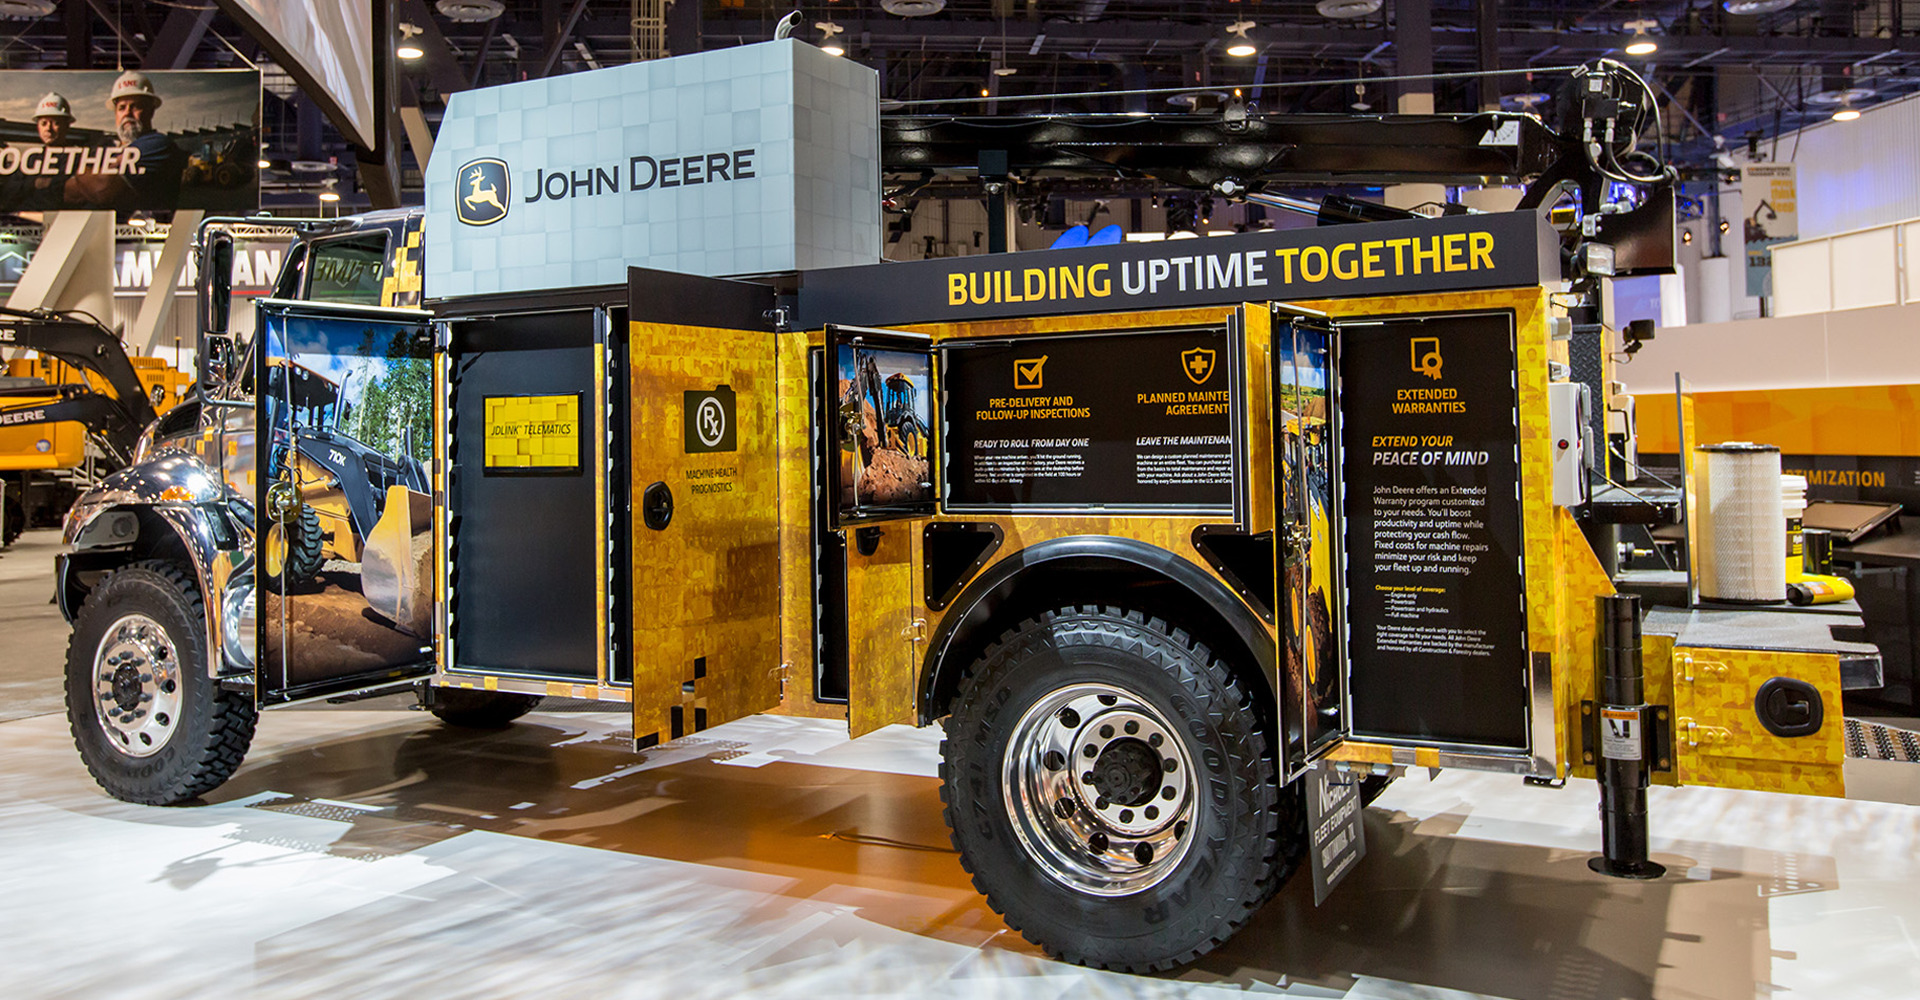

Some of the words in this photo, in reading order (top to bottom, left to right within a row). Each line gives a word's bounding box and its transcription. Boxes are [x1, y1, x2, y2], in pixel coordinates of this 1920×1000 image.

[0, 146, 146, 175] OGETHER.
[525, 165, 619, 203] JOHN
[630, 148, 756, 191] DEERE
[947, 262, 1111, 306] BUILDING
[1120, 250, 1268, 295] UPTIME
[1276, 231, 1495, 284] TOGETHER
[1137, 392, 1185, 404] PLANNED
[1188, 391, 1229, 402] MAINTE
[1397, 388, 1457, 401] EXTENDED
[989, 396, 1051, 408] PRE-DELIVERY
[1052, 396, 1073, 406] AND
[1391, 401, 1466, 414] WARRANTIES
[976, 409, 1029, 420] FOLLOW-UP
[1030, 408, 1091, 419] INSPECTIONS
[524, 424, 571, 435] TELEMATICS
[974, 440, 998, 448] READY
[999, 439, 1010, 448] TO
[1010, 439, 1029, 448] ROLL
[1031, 438, 1054, 448] FROM
[1055, 438, 1071, 447] DAY
[1071, 438, 1089, 447] ONE
[1136, 436, 1162, 446] LEAVE
[1162, 436, 1179, 445] THE
[1179, 435, 1232, 446] MAINTENAN
[1372, 436, 1418, 447] EXTEND
[1421, 435, 1453, 447] YOUR
[328, 448, 346, 466] 710K
[1372, 451, 1420, 465] PEACE
[1421, 451, 1443, 465] OF
[1444, 451, 1489, 465] MIND
[686, 468, 714, 480] MACHINE
[716, 467, 738, 478] HEALTH
[691, 482, 733, 494] PROGNOSTICS
[1373, 486, 1391, 494] John
[1392, 485, 1414, 494] Deere
[1415, 485, 1438, 494] offers
[1450, 486, 1487, 494] Extended
[1373, 496, 1407, 507] Warranty
[1408, 498, 1440, 507] program
[1441, 497, 1485, 506] customized
[1382, 509, 1400, 518] your
[1401, 508, 1426, 516] needs.
[1427, 508, 1448, 516] You'll
[1449, 508, 1471, 517] boost
[1374, 519, 1418, 529] productivity
[1418, 519, 1434, 528] and
[1434, 520, 1462, 530] uptime
[1463, 520, 1484, 528] while
[1374, 530, 1413, 541] protecting
[1413, 532, 1431, 541] your
[1432, 530, 1450, 539] cash
[1451, 530, 1470, 539] flow.
[1374, 540, 1394, 549] Fixed
[1416, 541, 1428, 550] for
[1428, 541, 1461, 550] machine
[1462, 544, 1489, 553] repairs
[1374, 552, 1408, 561] minimize
[1408, 554, 1426, 563] your
[1427, 553, 1441, 561] risk
[1442, 553, 1457, 562] and
[1458, 554, 1477, 564] keep
[1374, 564, 1392, 573] your
[1392, 563, 1410, 572] fleet
[1411, 565, 1422, 573] up
[1423, 564, 1438, 572] and
[1439, 565, 1471, 575] running.
